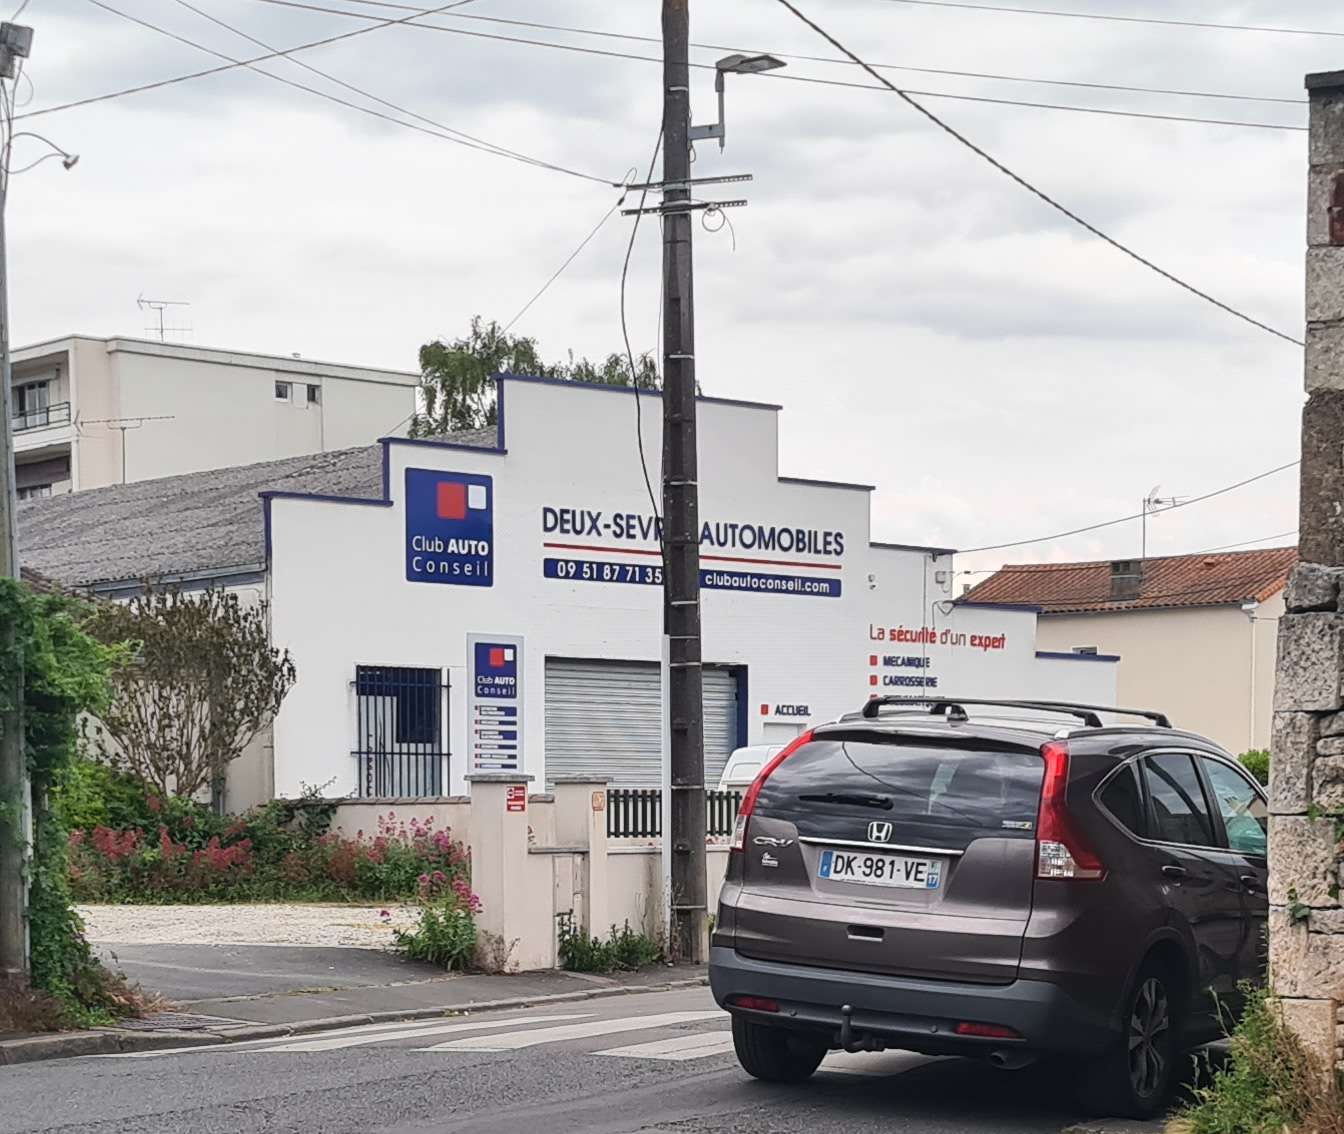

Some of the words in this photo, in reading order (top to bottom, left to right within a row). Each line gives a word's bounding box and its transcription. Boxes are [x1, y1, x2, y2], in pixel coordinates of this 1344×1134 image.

[543, 506, 665, 542] DEUX-SEVR
[699, 521, 845, 556] AUTOMOBILES
[412, 535, 444, 553] Club
[447, 538, 489, 556] AUTO
[412, 556, 488, 577] Conseil
[557, 561, 576, 577] 09
[582, 563, 597, 579] 51
[603, 564, 620, 581] 87
[625, 566, 640, 582] 71
[645, 567, 663, 584] 35
[705, 572, 830, 593] clubautoconseil.com
[869, 624, 885, 640] La
[889, 625, 937, 644] sécurité
[940, 629, 967, 646] d'un
[970, 633, 1006, 651] expert
[883, 656, 931, 668] MECANIQUE
[477, 685, 515, 696] Conseil
[494, 676, 516, 685] AUTO
[883, 675, 938, 687] CARROSSERIE
[774, 704, 812, 716] ACCUEIL
[833, 854, 928, 883] DK-981-VE
